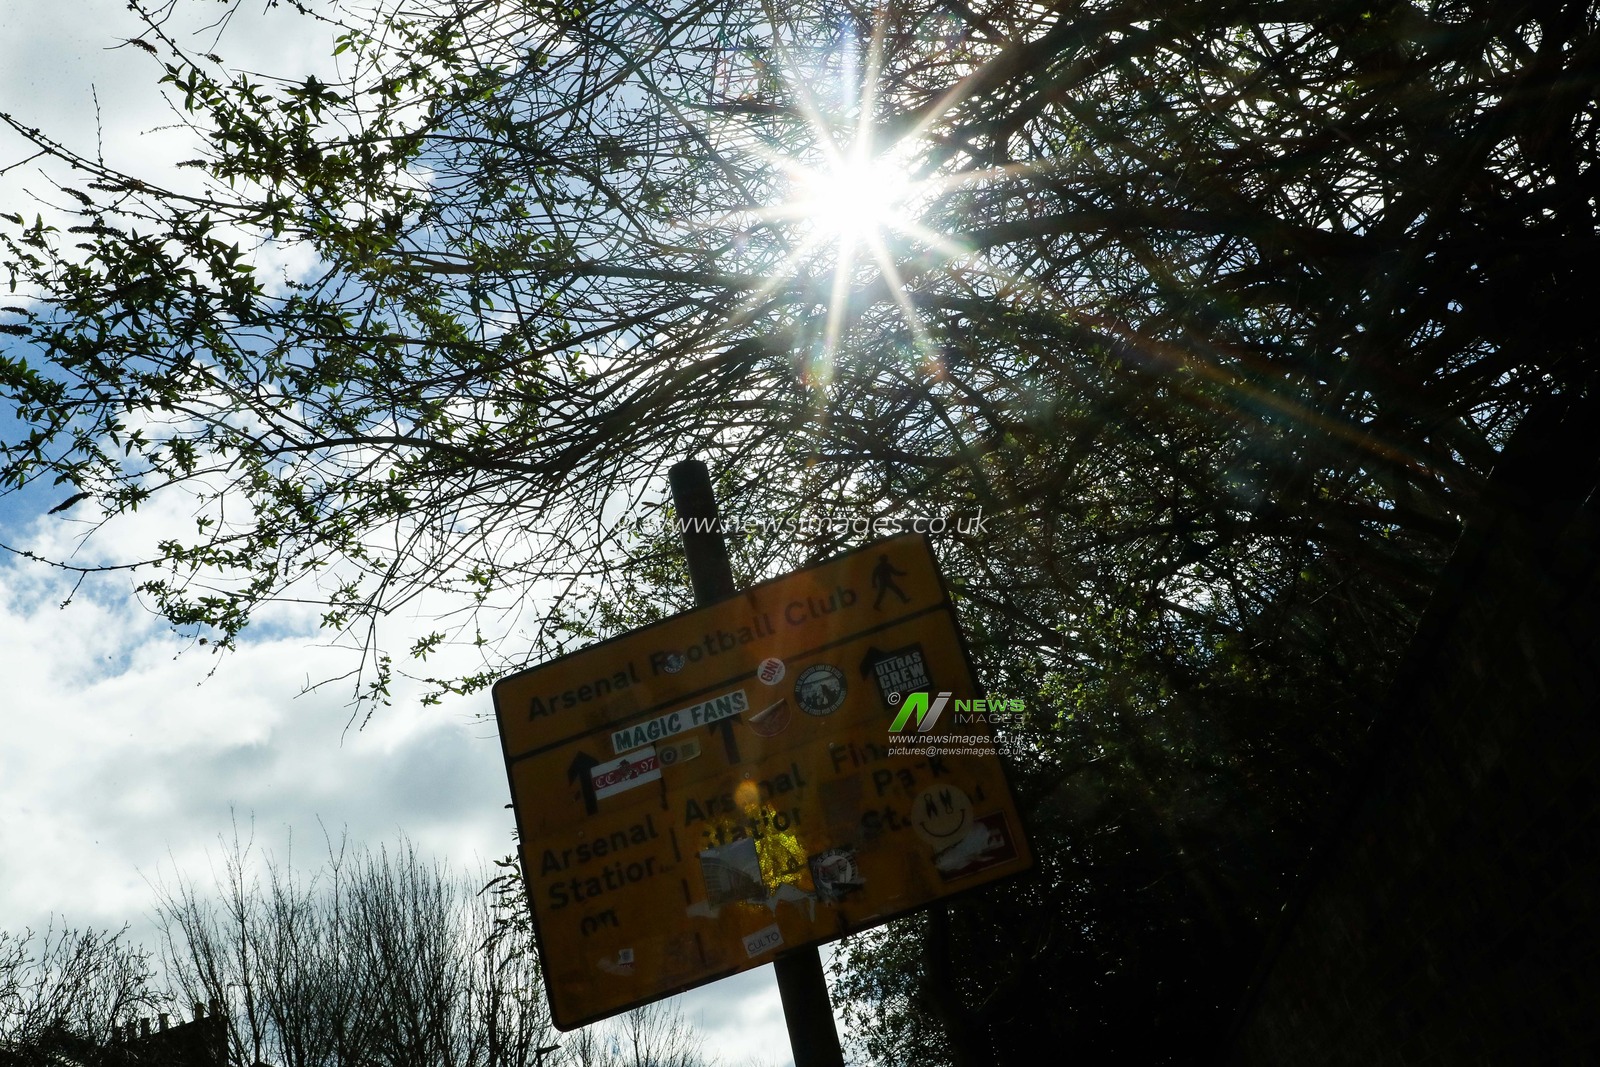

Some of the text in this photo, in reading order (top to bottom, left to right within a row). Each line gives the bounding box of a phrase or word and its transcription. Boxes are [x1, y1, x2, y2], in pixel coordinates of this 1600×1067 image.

[529, 586, 857, 721] Arsenal Fotball Club
[875, 651, 922, 676] ULTRAS
[879, 662, 925, 689] CREW
[614, 691, 746, 750] MAGIC FANS
[640, 757, 656, 773] 97
[685, 763, 806, 827] Arsnal
[541, 814, 659, 877] Arsenal
[747, 931, 780, 952] CULTO
